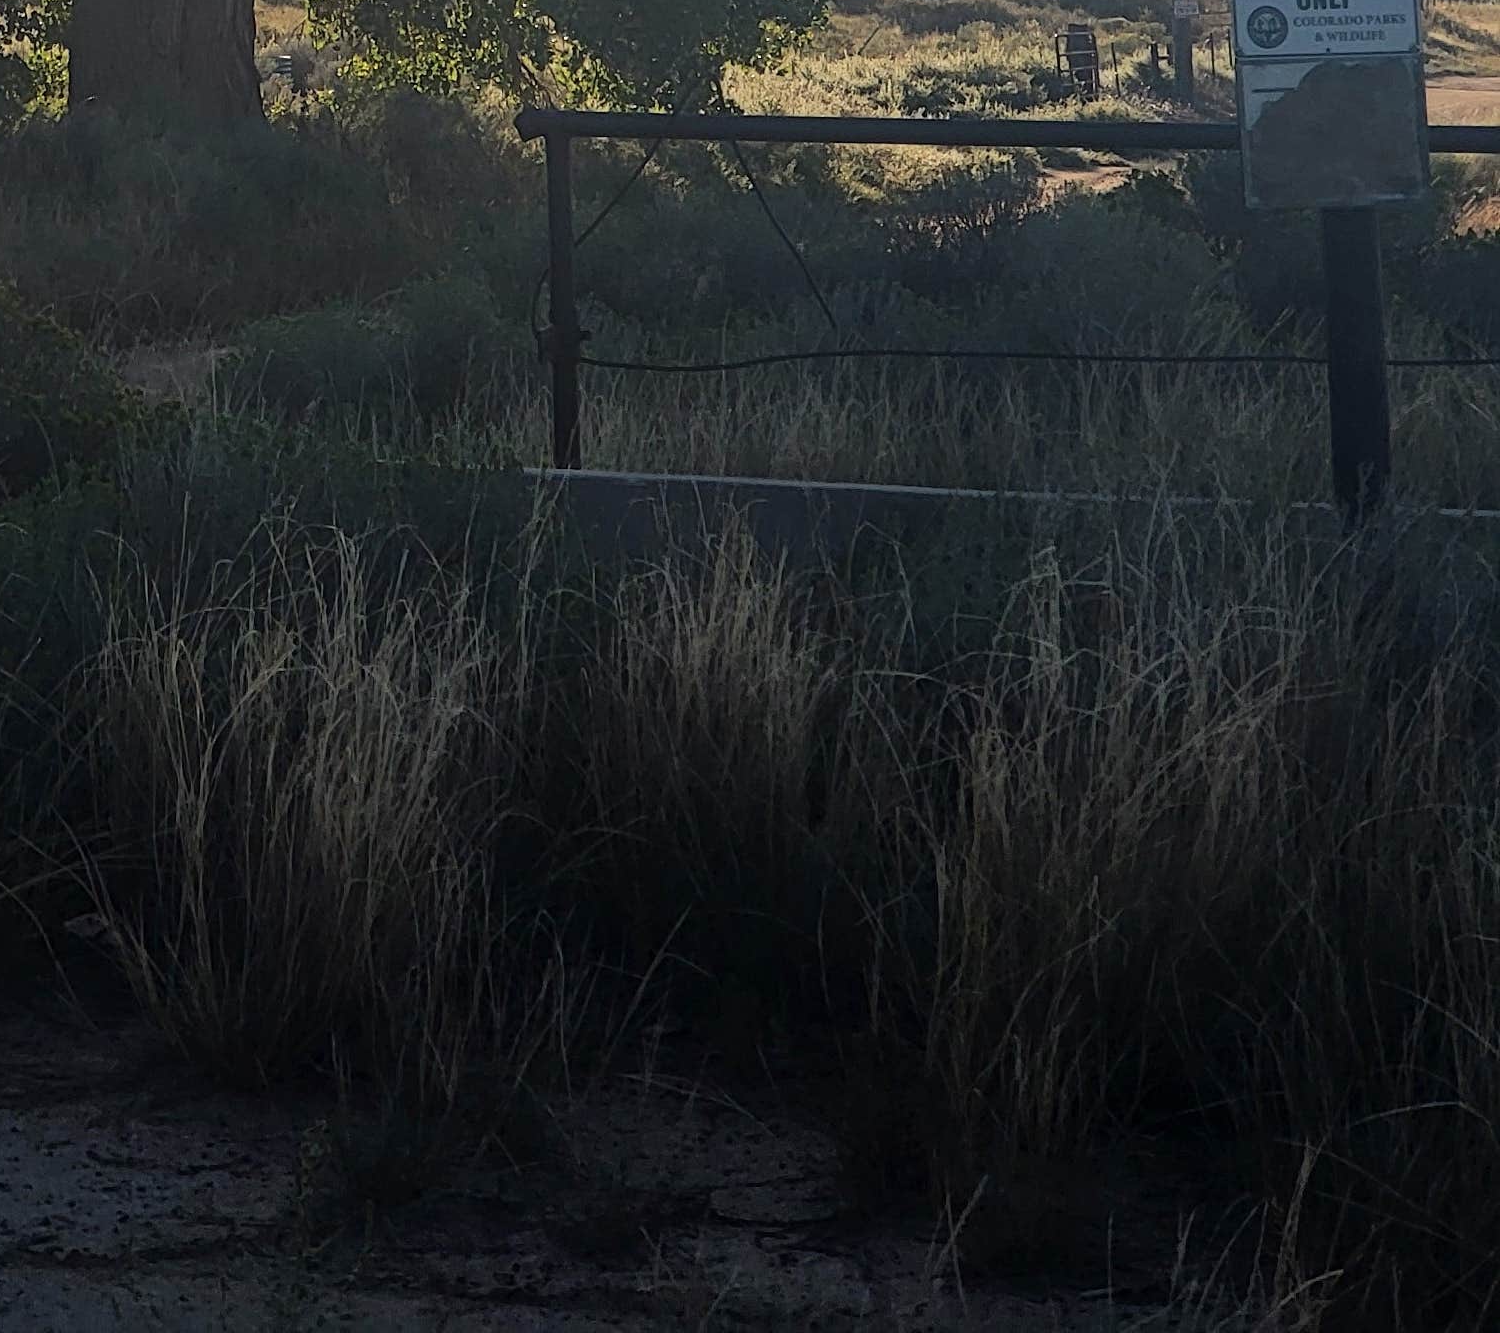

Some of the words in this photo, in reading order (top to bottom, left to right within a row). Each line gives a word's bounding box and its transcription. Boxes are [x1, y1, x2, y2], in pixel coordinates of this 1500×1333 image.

[1293, 15, 1362, 28] COLORADO
[1366, 13, 1407, 26] PARKS
[1315, 32, 1324, 42] &
[1326, 30, 1386, 43] WILDLIFE
